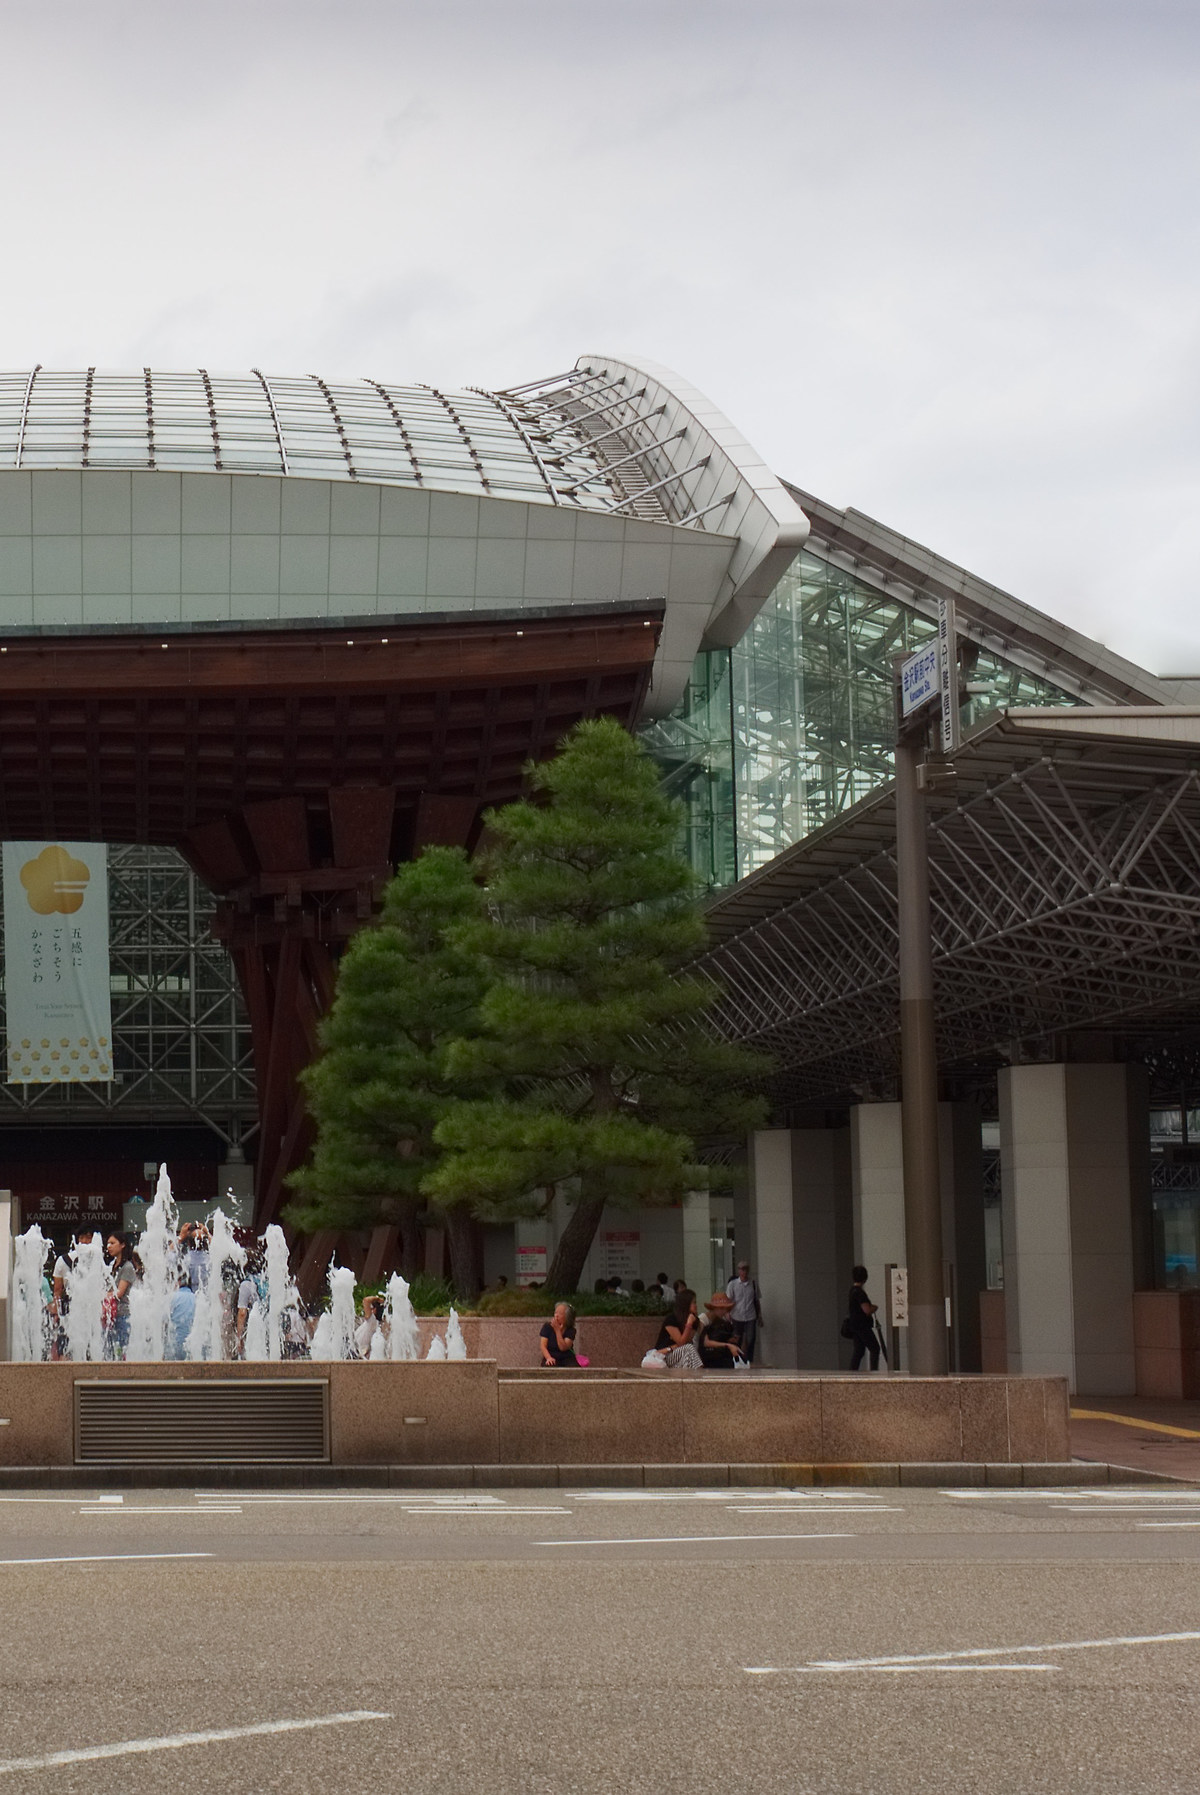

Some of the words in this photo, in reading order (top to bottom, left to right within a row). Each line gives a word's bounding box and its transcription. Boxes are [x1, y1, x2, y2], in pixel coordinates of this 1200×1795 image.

[31, 929, 43, 983] かなざわ
[53, 928, 63, 982] ごちそう
[71, 927, 83, 967] 五感に
[26, 1212, 79, 1221] KANAZAWA
[81, 1211, 117, 1221] STATION
[40, 1196, 104, 1210] 金沢駅
